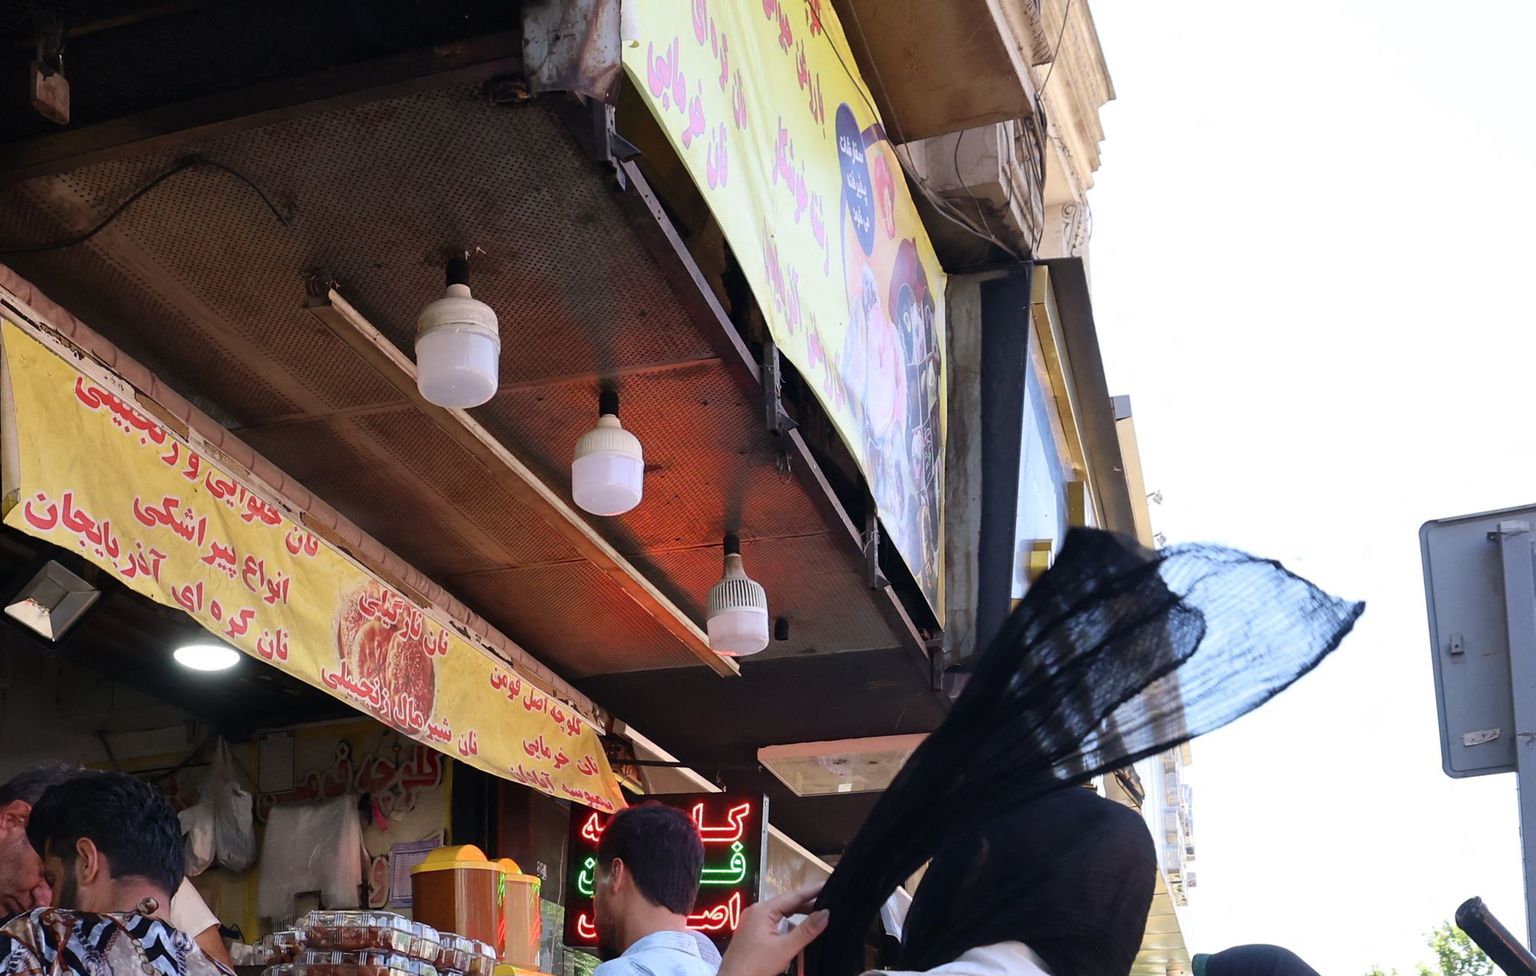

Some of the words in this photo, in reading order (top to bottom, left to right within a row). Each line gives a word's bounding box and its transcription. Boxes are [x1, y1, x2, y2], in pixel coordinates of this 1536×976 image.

[707, 121, 729, 191] نان
[241, 553, 292, 606] انواع
[256, 628, 291, 662] نان
[422, 628, 450, 657] نان
[490, 666, 522, 701] فومن
[522, 690, 548, 716] اصل
[549, 704, 583, 737] کلوچه
[457, 730, 479, 757] نان
[576, 754, 600, 778] نان
